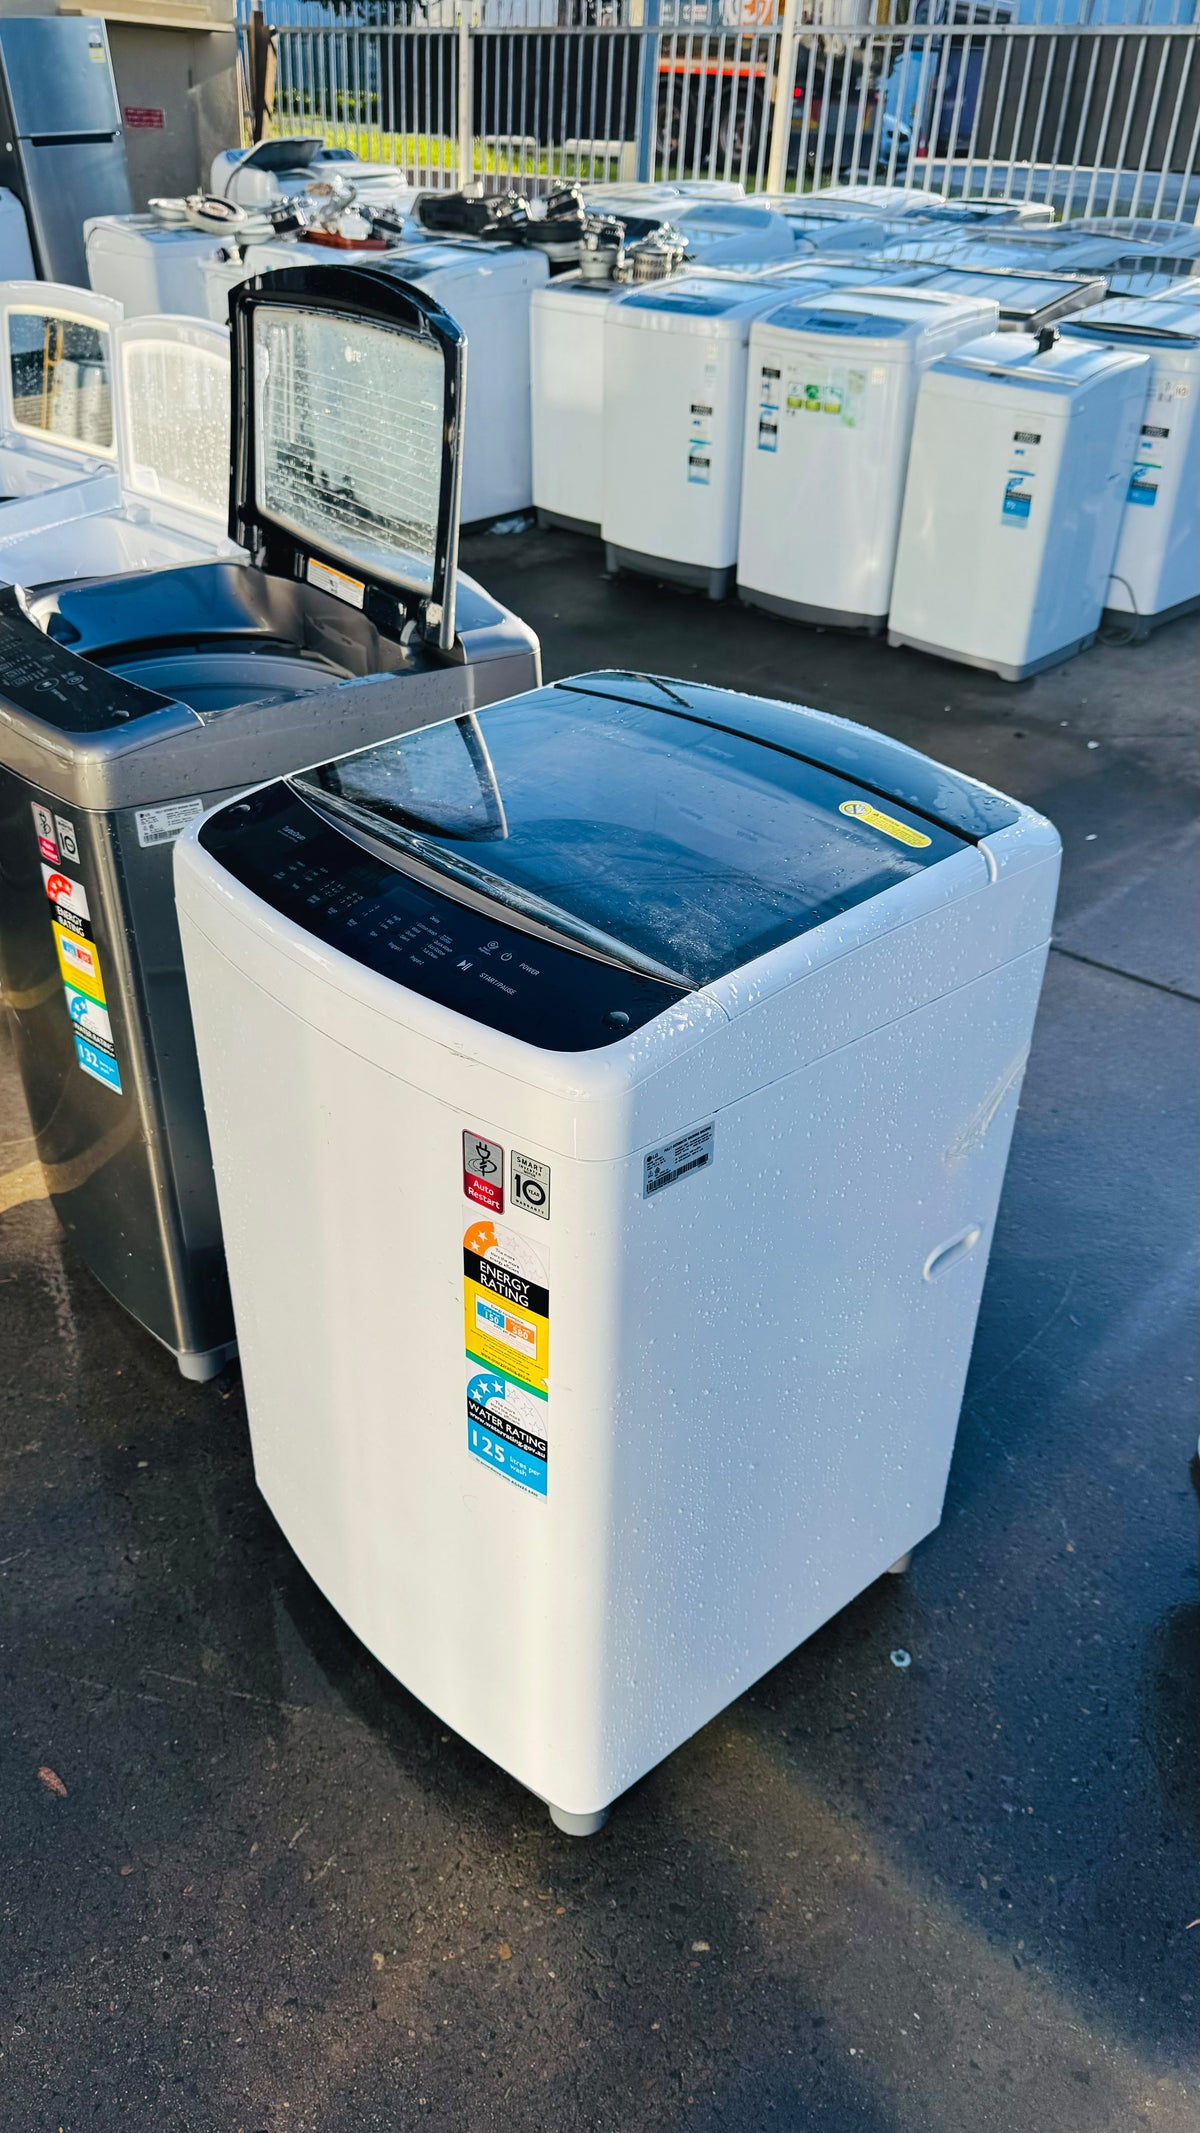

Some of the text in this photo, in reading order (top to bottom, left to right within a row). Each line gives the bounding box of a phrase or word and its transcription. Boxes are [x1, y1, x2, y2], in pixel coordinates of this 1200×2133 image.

[60, 832, 76, 855] 10
[55, 905, 82, 927] ENERGY
[57, 915, 85, 937] RATING
[519, 963, 540, 976] POWER
[480, 972, 517, 995] START/PAUSE
[79, 1044, 99, 1068] 132
[516, 1156, 543, 1173] SMART
[468, 1186, 500, 1209] Restart
[473, 1180, 494, 1196] Auto
[514, 1173, 546, 1206] 10
[527, 1189, 540, 1197] YEAR
[515, 1199, 544, 1214] WARRANTY
[479, 1260, 530, 1294] ENERGY
[480, 1273, 529, 1307] RATING
[484, 1311, 499, 1325] 150
[512, 1326, 529, 1340] 580
[468, 1400, 546, 1451] WATER RATING
[469, 1411, 546, 1458] www.waterrating.gov.au
[472, 1429, 505, 1463] 125
[509, 1455, 527, 1470] litres
[528, 1467, 541, 1476] per
[510, 1465, 527, 1477] wash
